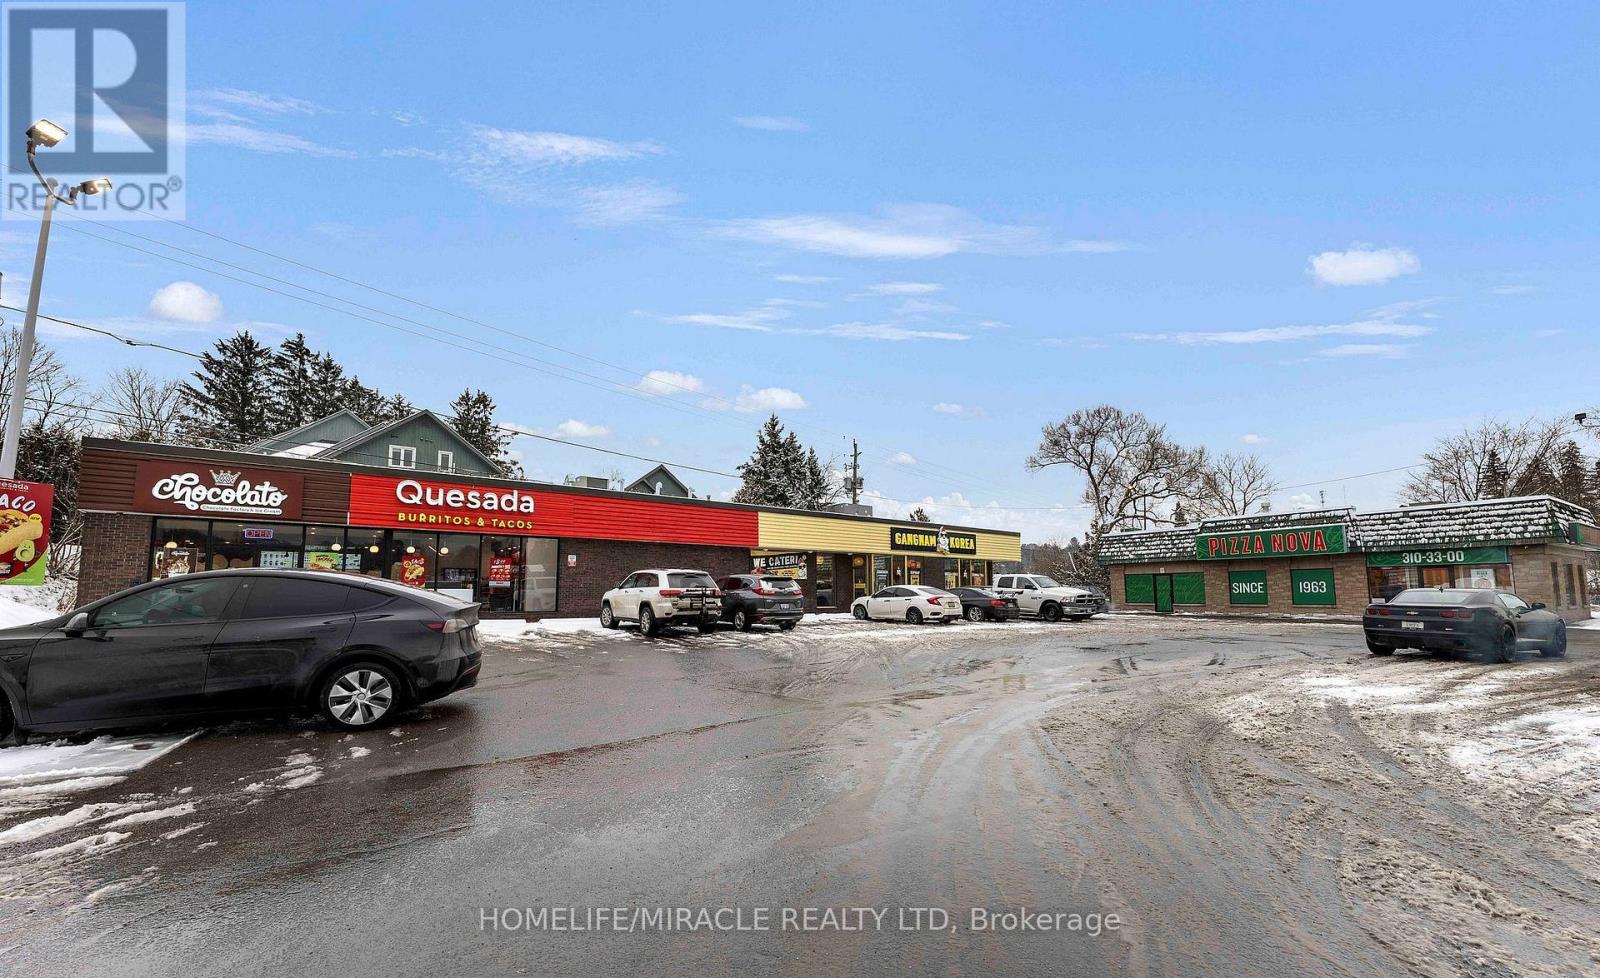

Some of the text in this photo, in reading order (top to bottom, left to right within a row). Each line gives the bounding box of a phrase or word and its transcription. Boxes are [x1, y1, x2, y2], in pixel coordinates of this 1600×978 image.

[0, 482, 29, 490] esada
[152, 472, 288, 510] Chocolato
[396, 480, 535, 513] Quesada
[398, 512, 533, 530] BURRITOS & TACOS
[895, 532, 975, 549] GANGNAM KOREA
[1208, 530, 1327, 557] PIZZA NOVA
[753, 557, 766, 567] WE
[1402, 550, 1465, 564] 310-33-00
[1232, 582, 1265, 594] SINCE
[1299, 581, 1326, 593] 1963
